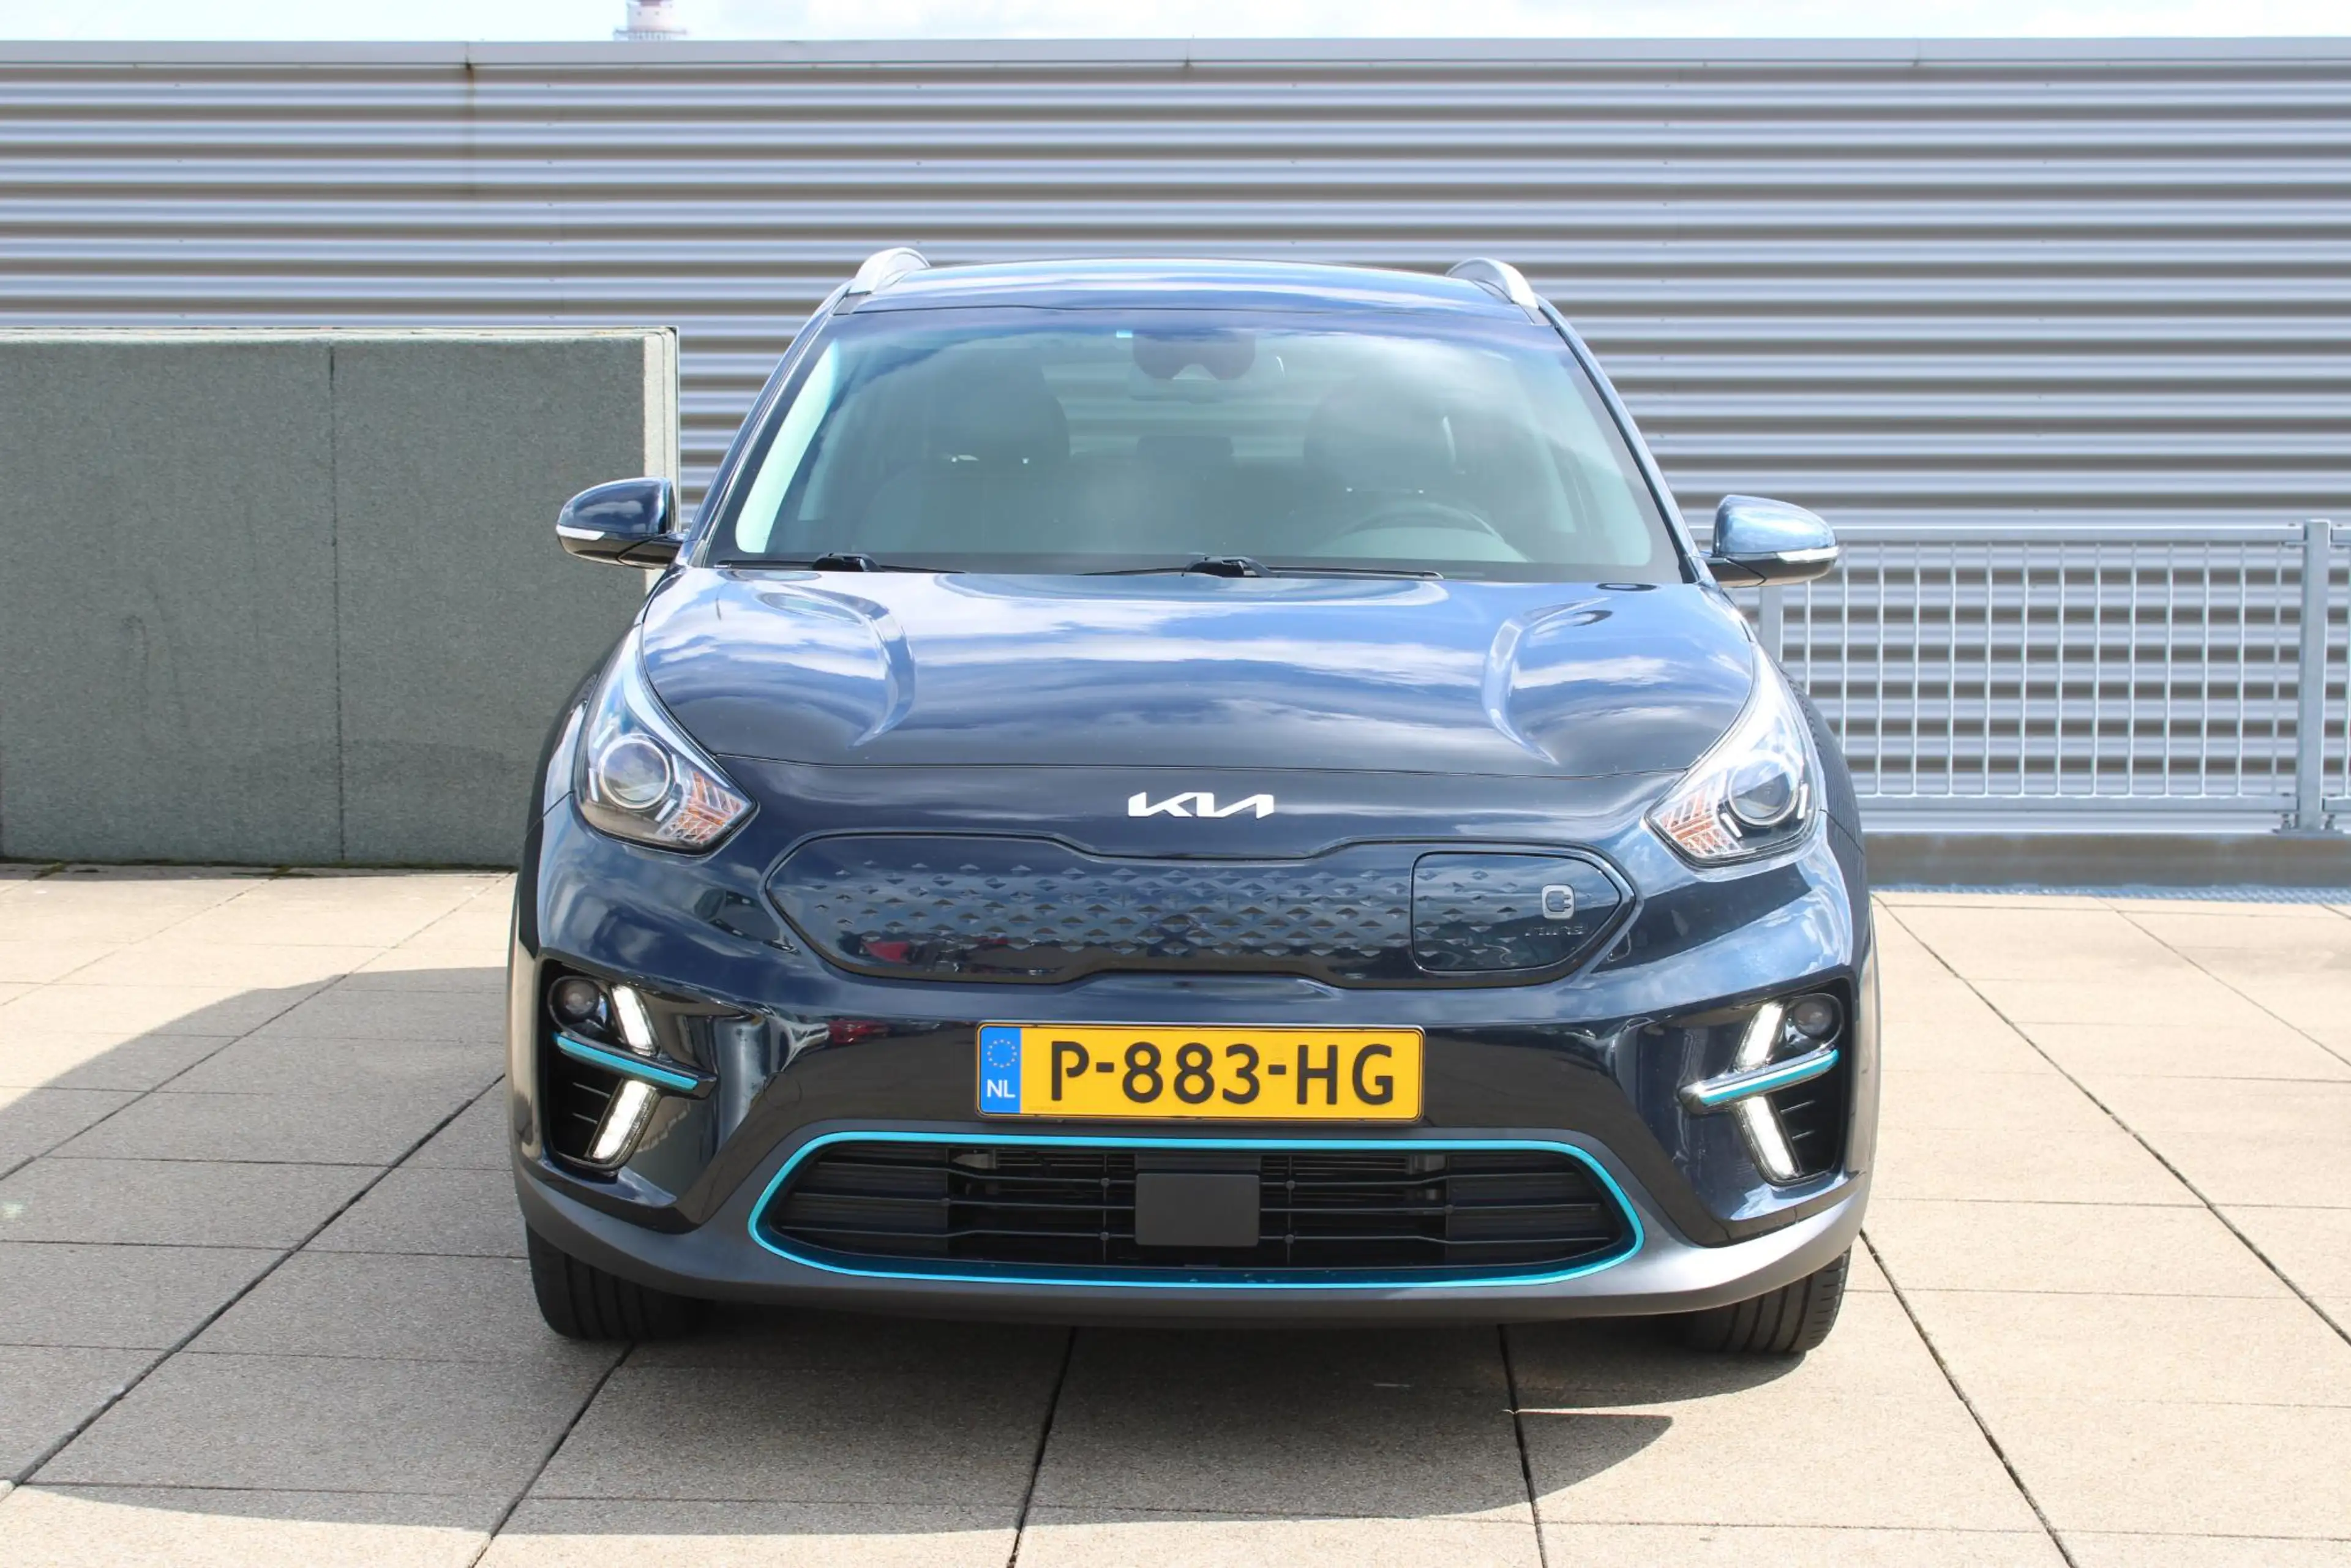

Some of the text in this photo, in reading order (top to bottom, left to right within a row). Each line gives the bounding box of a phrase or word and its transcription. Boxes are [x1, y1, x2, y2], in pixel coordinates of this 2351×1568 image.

[1128, 792, 1274, 819] KIA
[1051, 1041, 1394, 1105] P-883-HG
[987, 1080, 1016, 1098] NL
